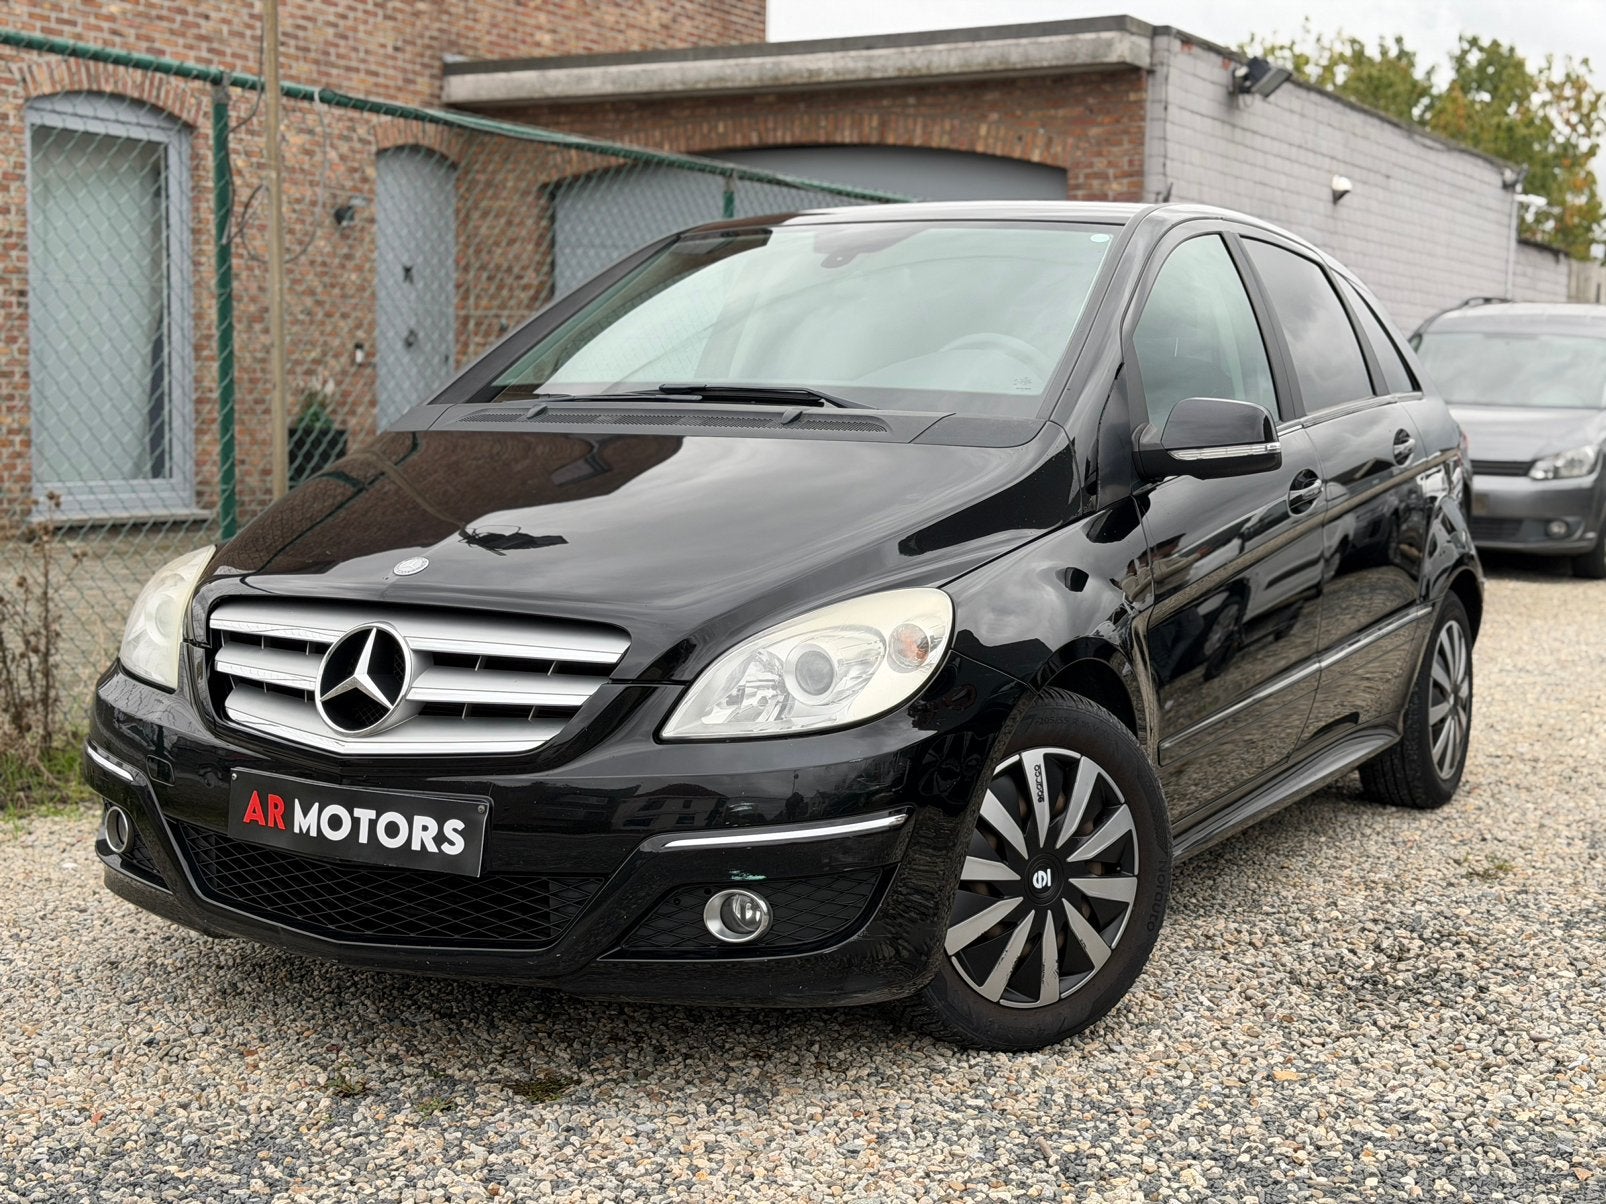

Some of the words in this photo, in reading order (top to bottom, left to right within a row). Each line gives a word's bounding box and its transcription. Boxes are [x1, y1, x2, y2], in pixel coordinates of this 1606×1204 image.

[1033, 763, 1045, 804] sparco
[243, 790, 286, 830] AR
[294, 798, 466, 855] MOTORS
